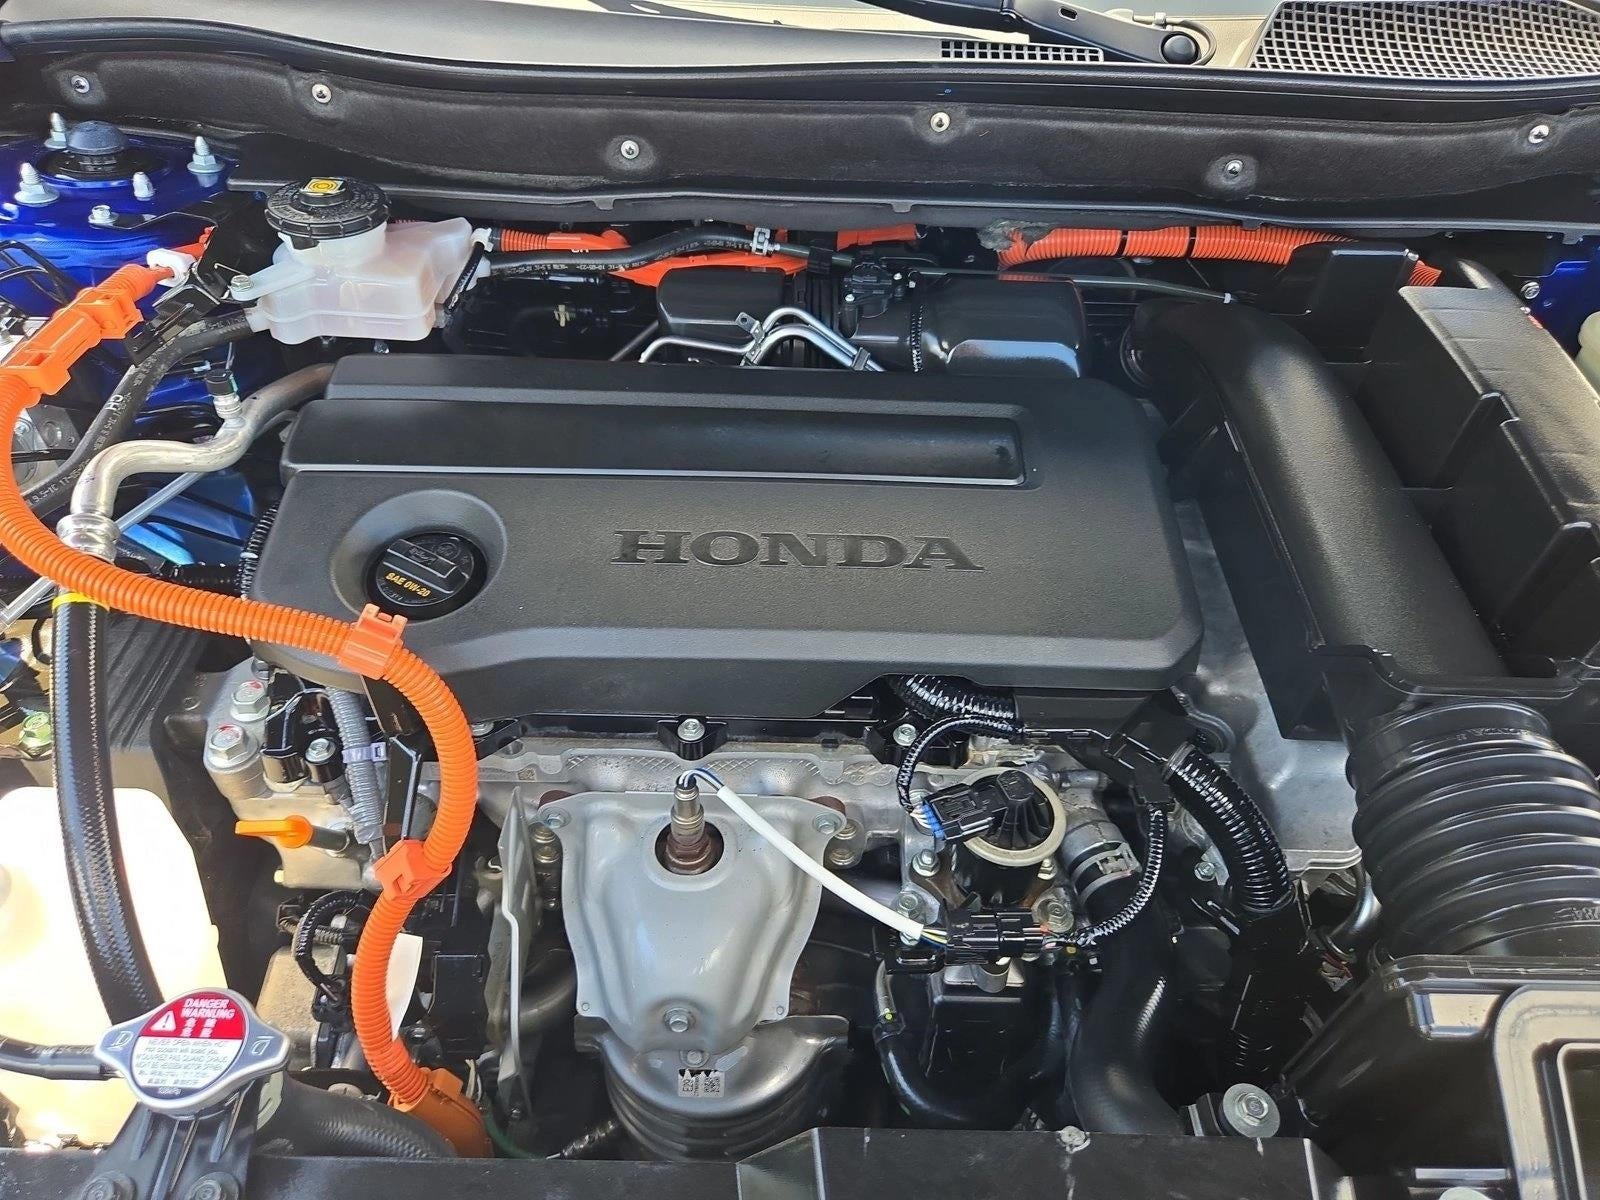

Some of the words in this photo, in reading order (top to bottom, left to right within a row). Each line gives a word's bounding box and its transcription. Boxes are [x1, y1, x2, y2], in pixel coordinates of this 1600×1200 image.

[611, 529, 985, 572] HONDA
[385, 572, 407, 585] SAE
[403, 581, 432, 597] 0W-20
[184, 998, 230, 1009] DANGER
